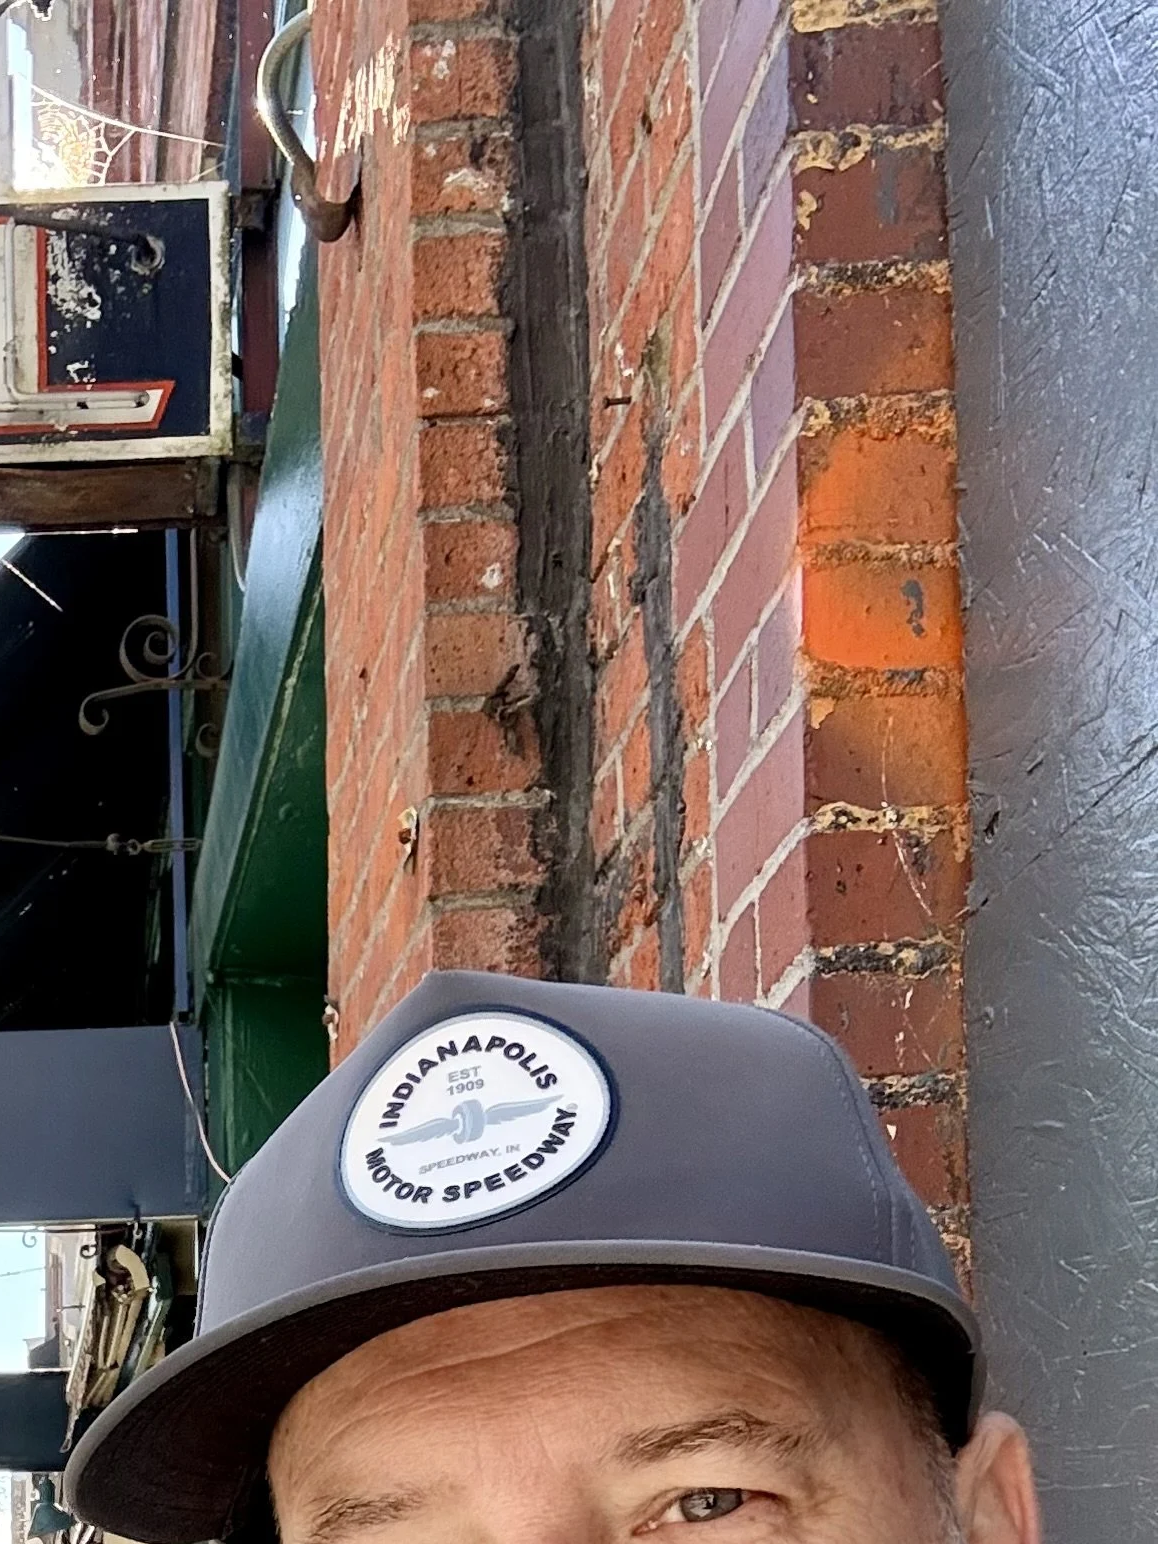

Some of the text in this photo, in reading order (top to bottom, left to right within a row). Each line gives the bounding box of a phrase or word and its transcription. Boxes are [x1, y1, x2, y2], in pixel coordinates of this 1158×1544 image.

[379, 1035, 558, 1129] INDIANAPOLIS
[446, 1078, 485, 1096] 1909
[447, 1065, 482, 1083] EST
[365, 1106, 578, 1204] MOTOR SPEEDWAY
